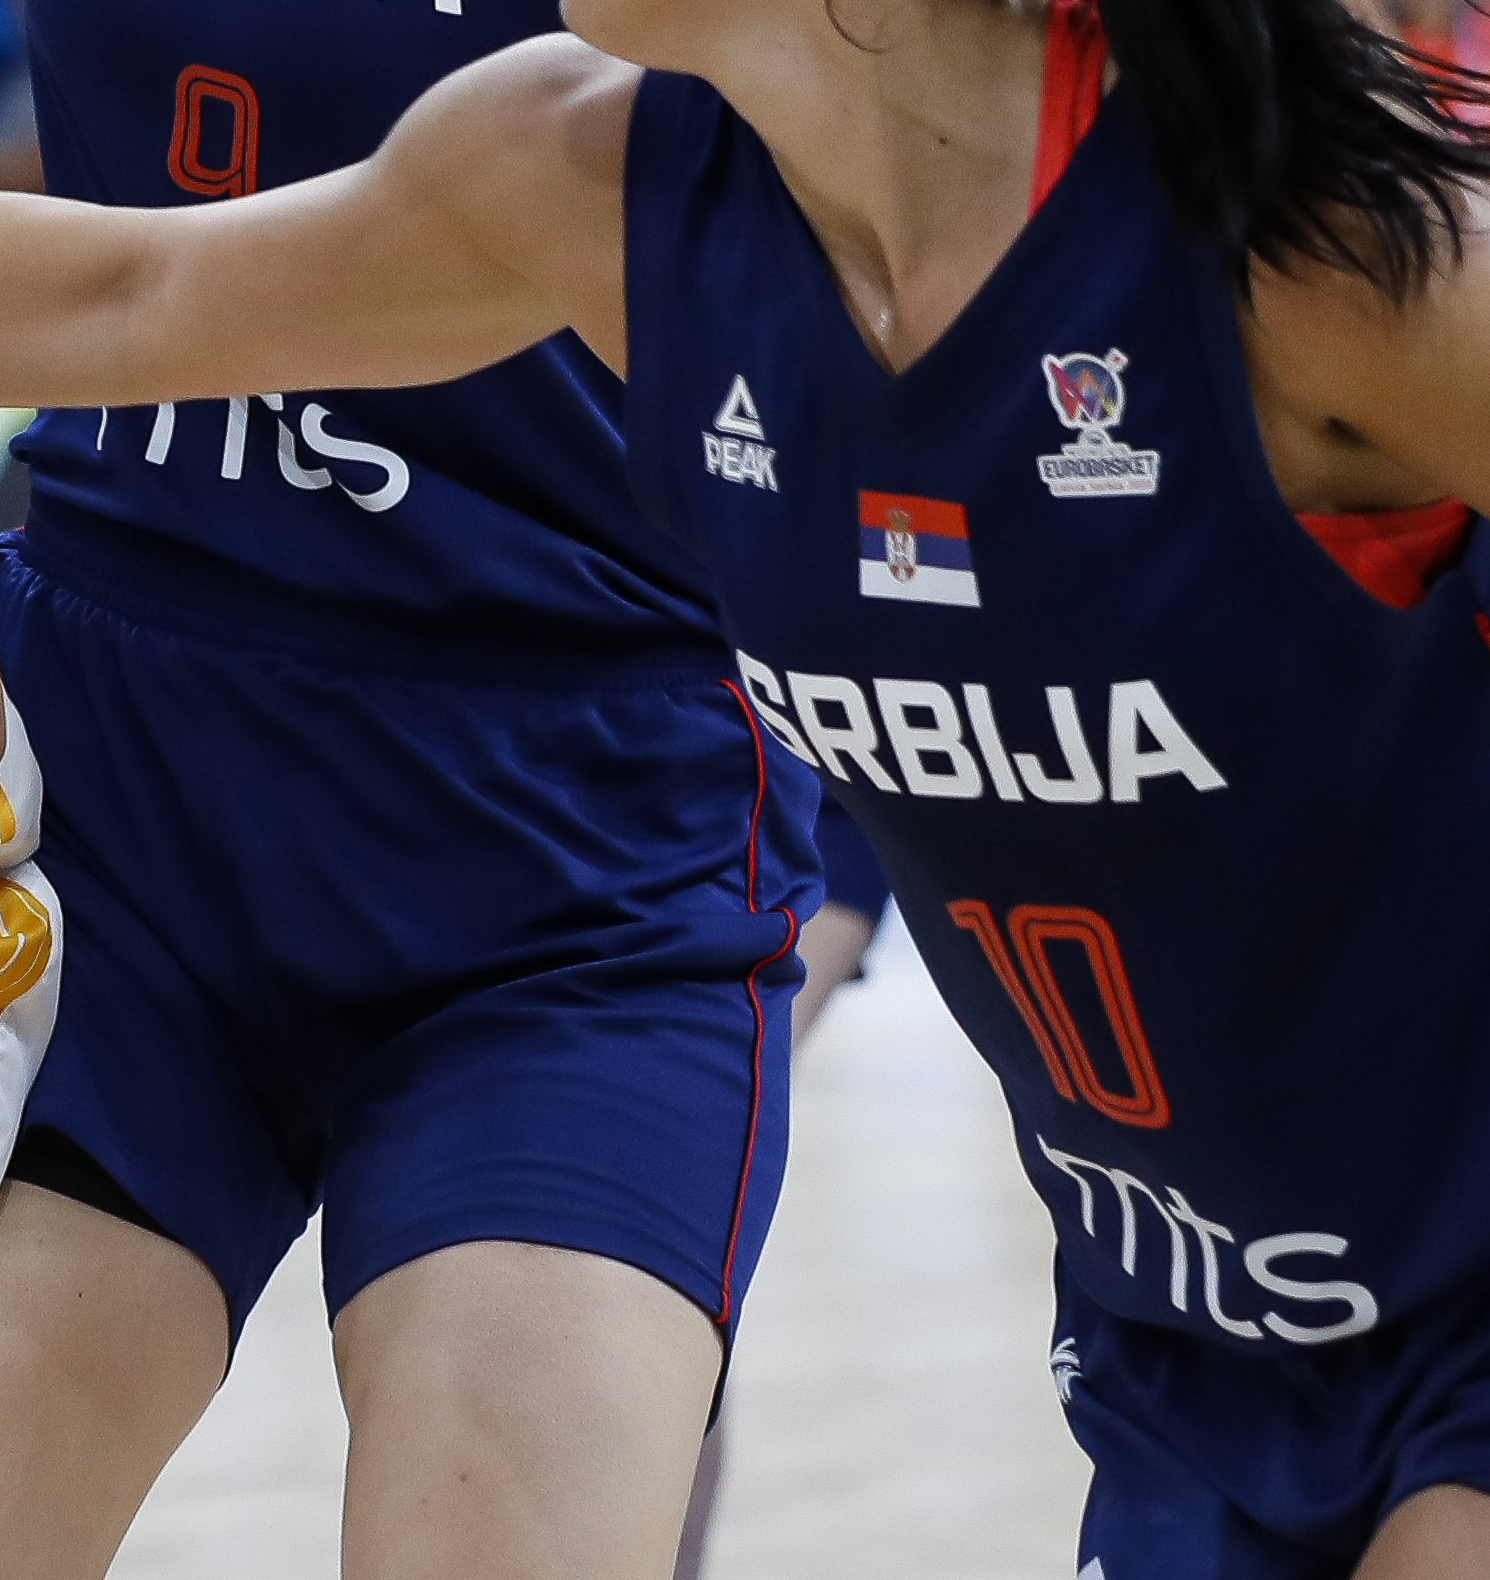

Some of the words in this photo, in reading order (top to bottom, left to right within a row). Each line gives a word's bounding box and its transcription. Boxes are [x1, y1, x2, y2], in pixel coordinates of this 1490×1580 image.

[167, 63, 260, 199] 9
[701, 430, 779, 493] PEAK
[734, 647, 1229, 803] SRBIJA
[945, 898, 1171, 1131] 10
[1035, 1132, 1380, 1346] mts
